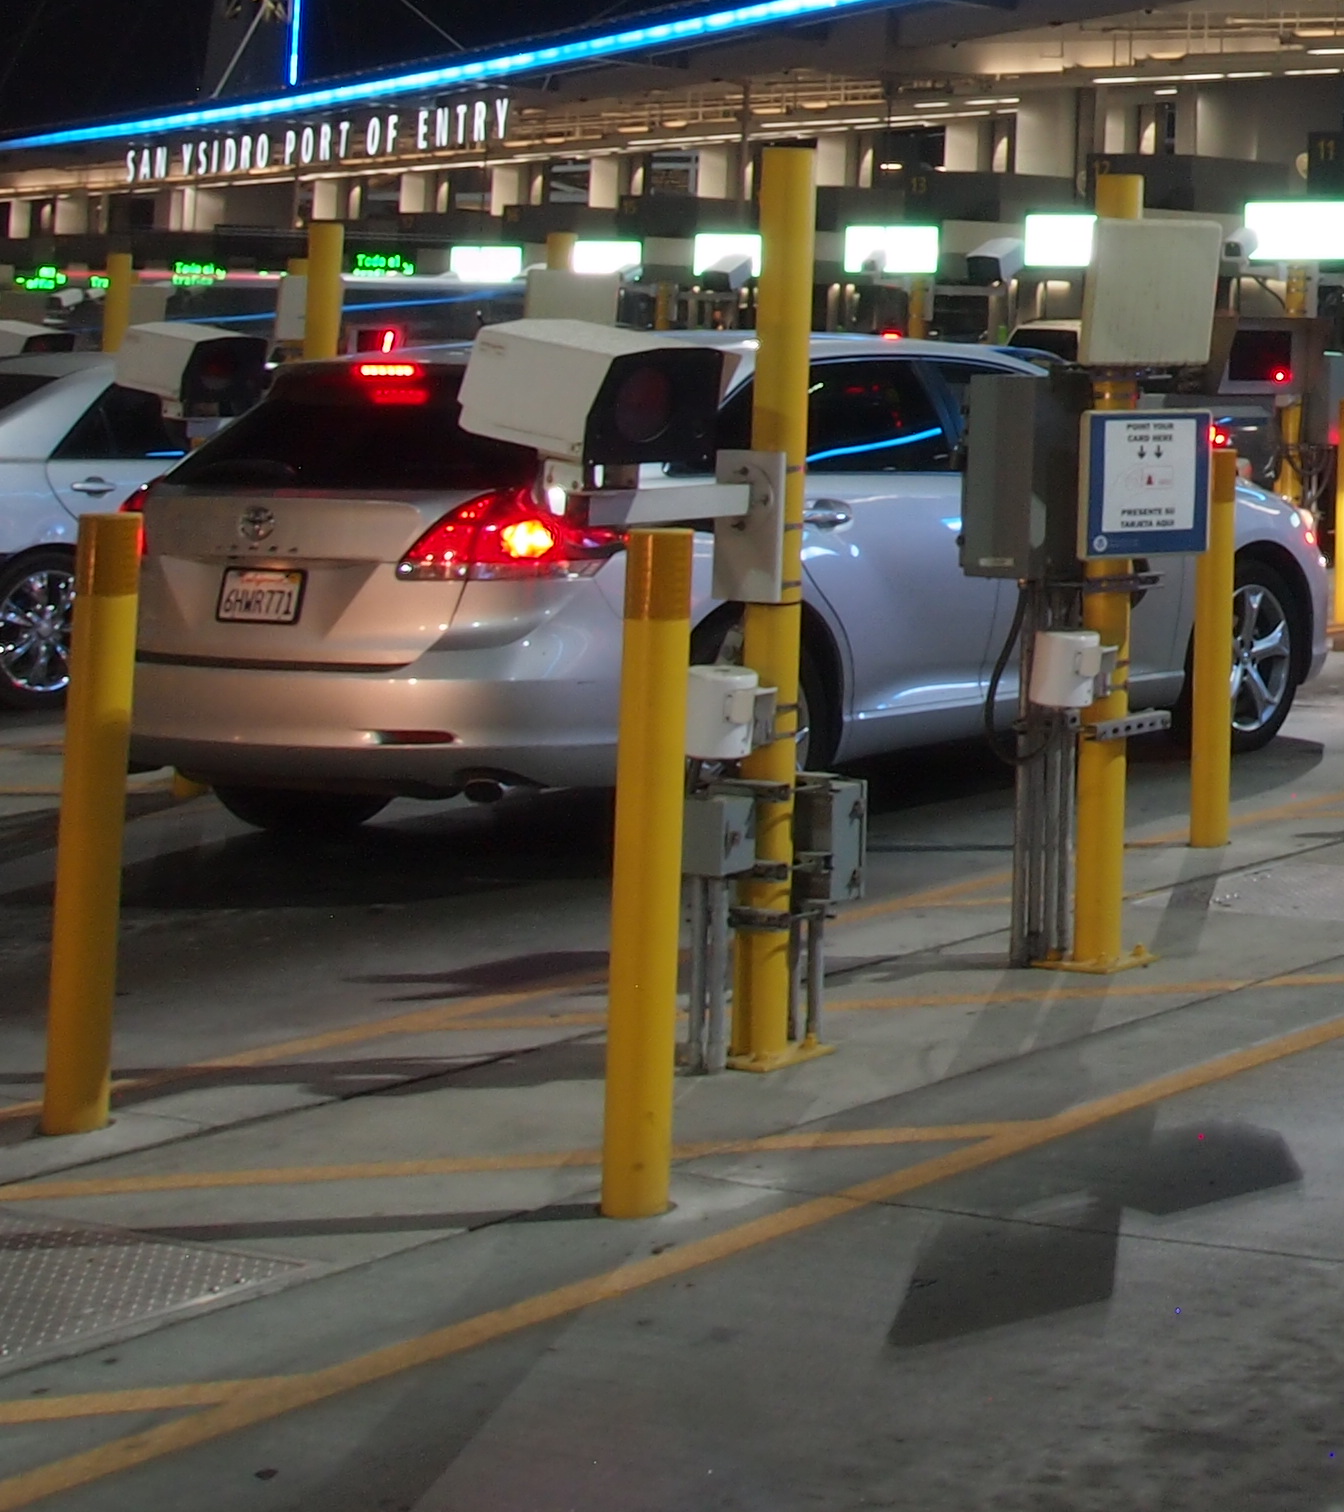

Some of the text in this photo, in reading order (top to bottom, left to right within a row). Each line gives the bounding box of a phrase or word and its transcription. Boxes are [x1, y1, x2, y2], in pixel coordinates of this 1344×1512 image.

[126, 98, 508, 183] SAN YSIDRO PORT OF ENTRY
[1316, 139, 1336, 163] 11
[1126, 422, 1175, 431] POINT YOUR
[1127, 434, 1173, 443] CARD HERE
[223, 588, 293, 616] 6HWR771
